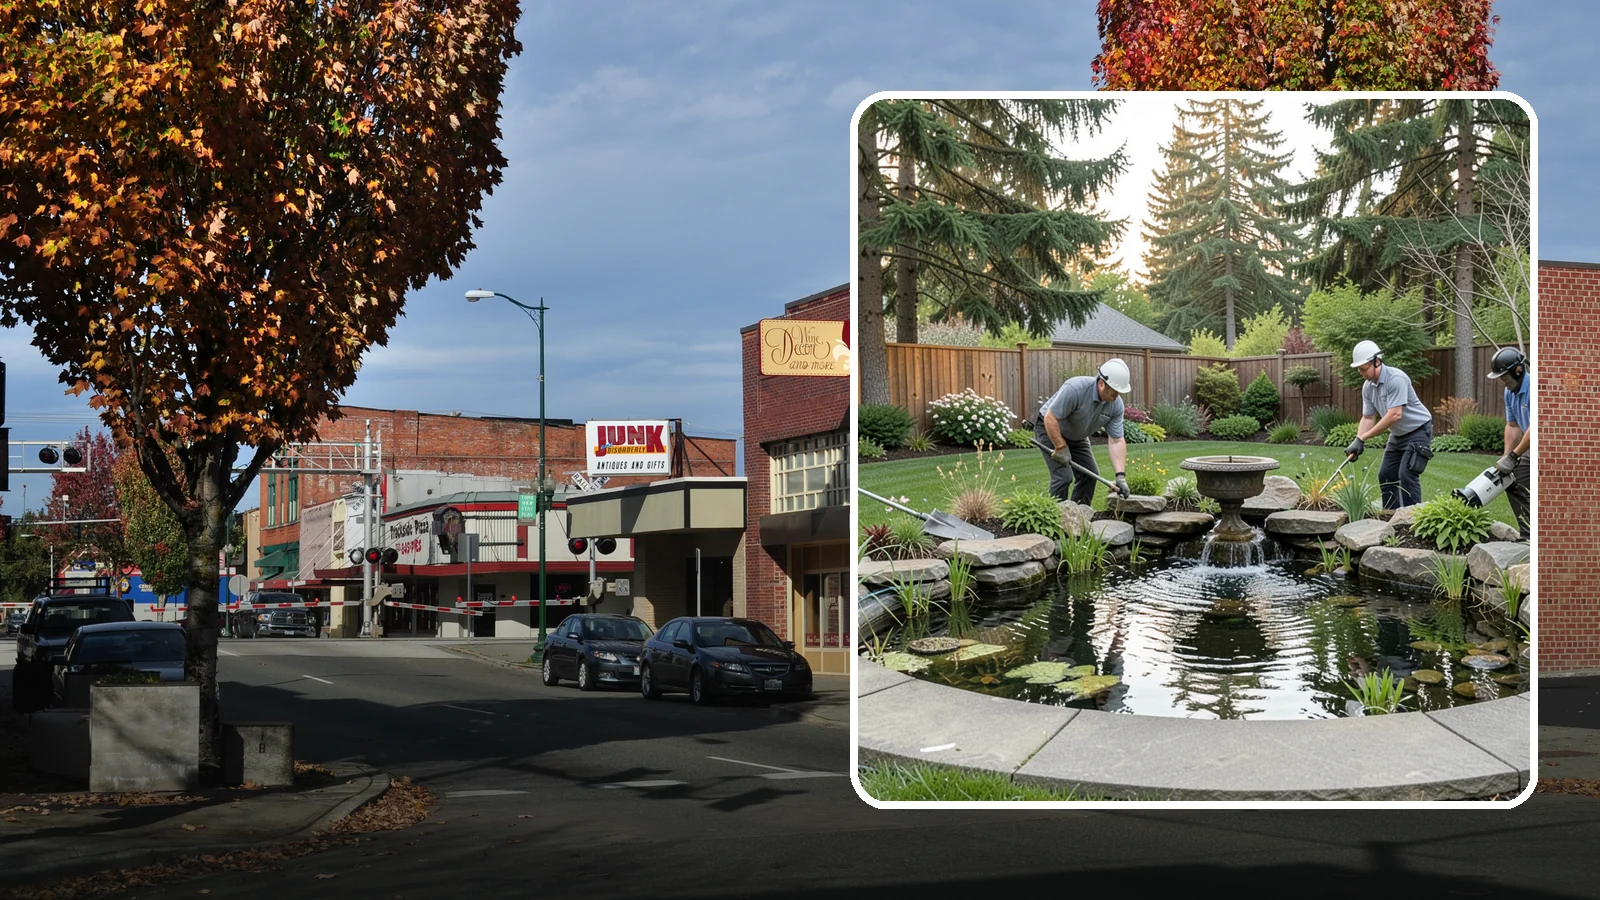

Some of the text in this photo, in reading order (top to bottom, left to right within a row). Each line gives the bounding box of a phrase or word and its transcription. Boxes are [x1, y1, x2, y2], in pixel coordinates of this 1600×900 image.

[595, 425, 665, 457] JUNK
[607, 446, 646, 454] DISORDERLY
[597, 460, 665, 470] ANTIQUES AND GIFTS
[390, 520, 429, 539] Trackside Pizza
